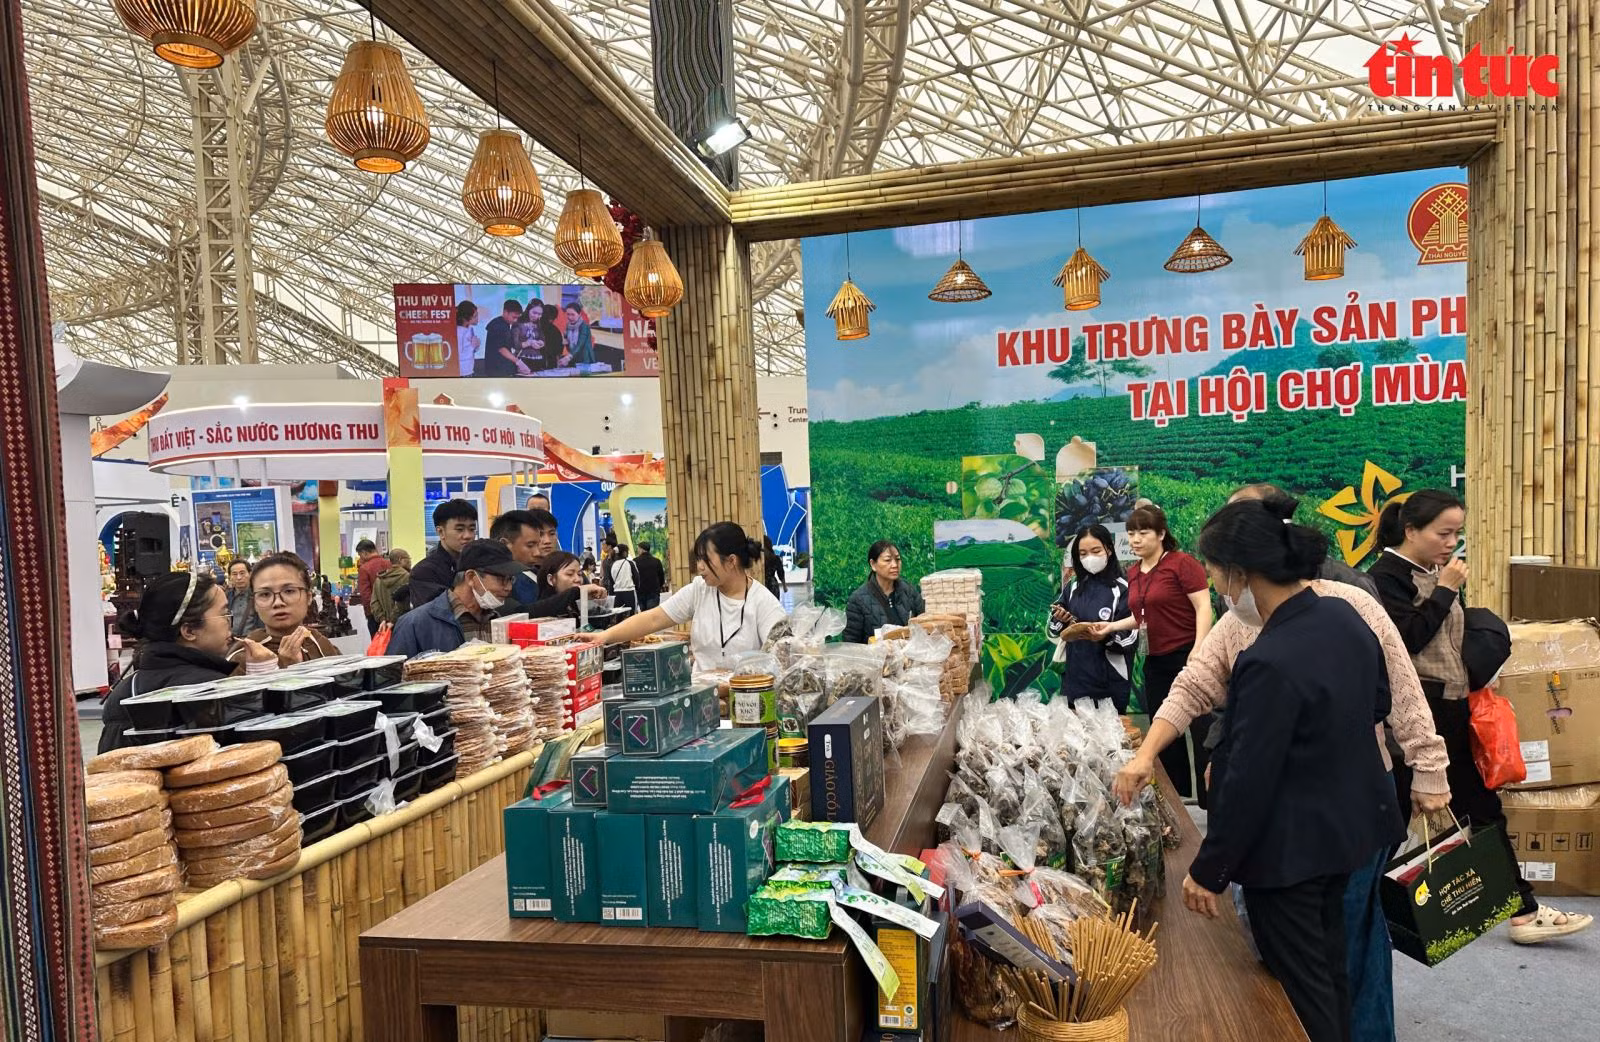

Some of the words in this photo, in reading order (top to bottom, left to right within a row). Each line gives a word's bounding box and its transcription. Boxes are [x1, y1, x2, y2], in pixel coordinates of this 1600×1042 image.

[397, 295, 418, 306] THU
[431, 310, 451, 319] FEST
[997, 327, 1071, 367] KHU
[1082, 315, 1209, 360] TRƯNG
[1222, 303, 1299, 349] BÀY
[1312, 291, 1397, 344] SẢN
[1127, 380, 1187, 425] TẠI
[1201, 367, 1265, 420] HỘI
[1279, 364, 1361, 414] CHỢ
[1374, 356, 1467, 404] MÙA
[175, 426, 196, 450] VIỆT
[206, 421, 233, 444] SẮC
[237, 421, 279, 442] NƯỚC
[284, 421, 342, 441] HƯƠNG
[346, 423, 379, 440] THU
[444, 425, 471, 445] THỌ
[482, 427, 497, 444] CƠ
[500, 428, 516, 448] HỘI
